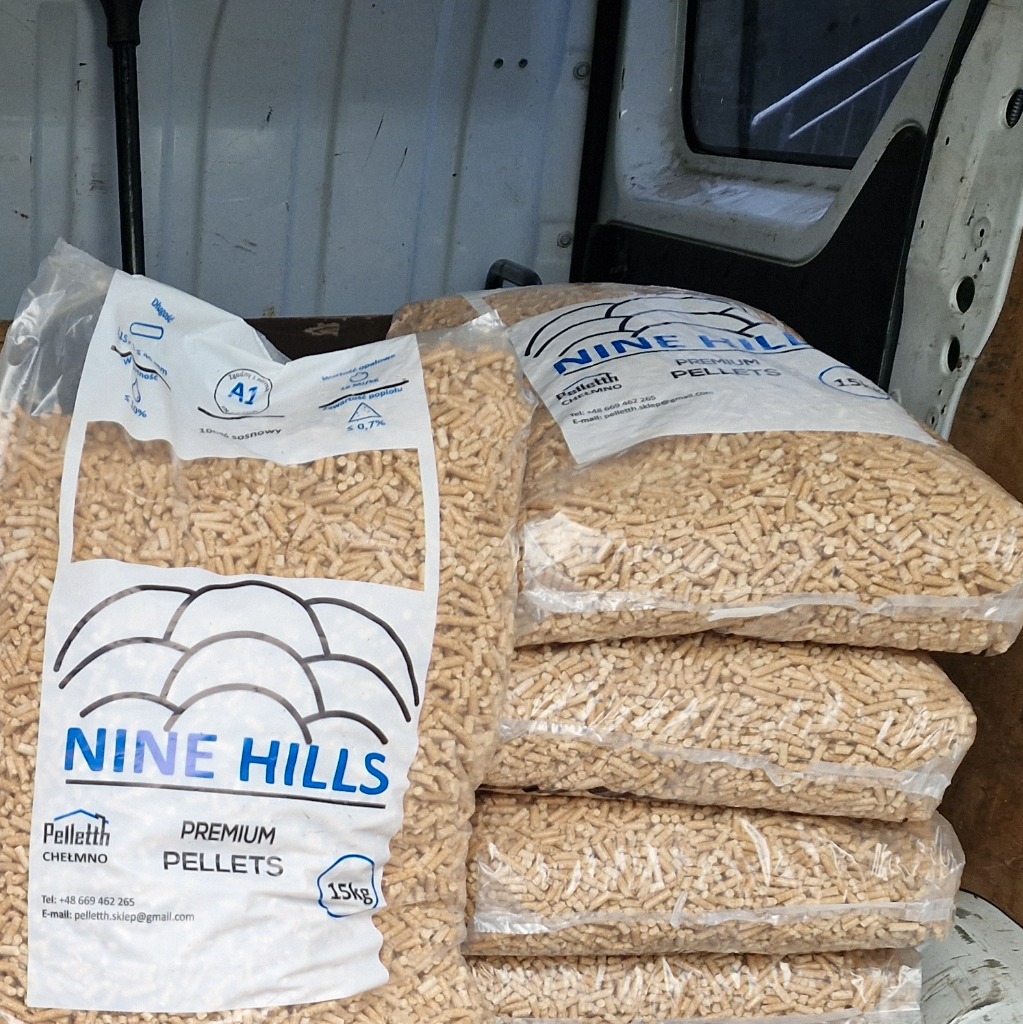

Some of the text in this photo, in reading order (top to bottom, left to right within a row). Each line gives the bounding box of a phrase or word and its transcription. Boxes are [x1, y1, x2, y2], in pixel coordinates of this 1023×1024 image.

[552, 331, 808, 375] NINE HILL
[675, 357, 760, 367] PREMIUM
[670, 368, 782, 379] PELLETS
[227, 382, 258, 405] A1
[556, 372, 619, 401] Pelletth
[586, 395, 657, 416] +48 669 462 265
[357, 419, 386, 431] 0,7%
[573, 415, 603, 425] E-mail:
[231, 428, 282, 442] sosnowy
[64, 727, 391, 795] NINE HILLS
[42, 813, 111, 848] Pelletth
[180, 820, 276, 845] PREMIUM
[42, 851, 108, 864] CHEŁMNO
[162, 850, 284, 878] PELLETS
[41, 894, 135, 908] Tel: +48 669 462 265
[328, 881, 373, 906] 15kg
[41, 909, 195, 925] E-mail: pelletth.sklep@gmail.com
